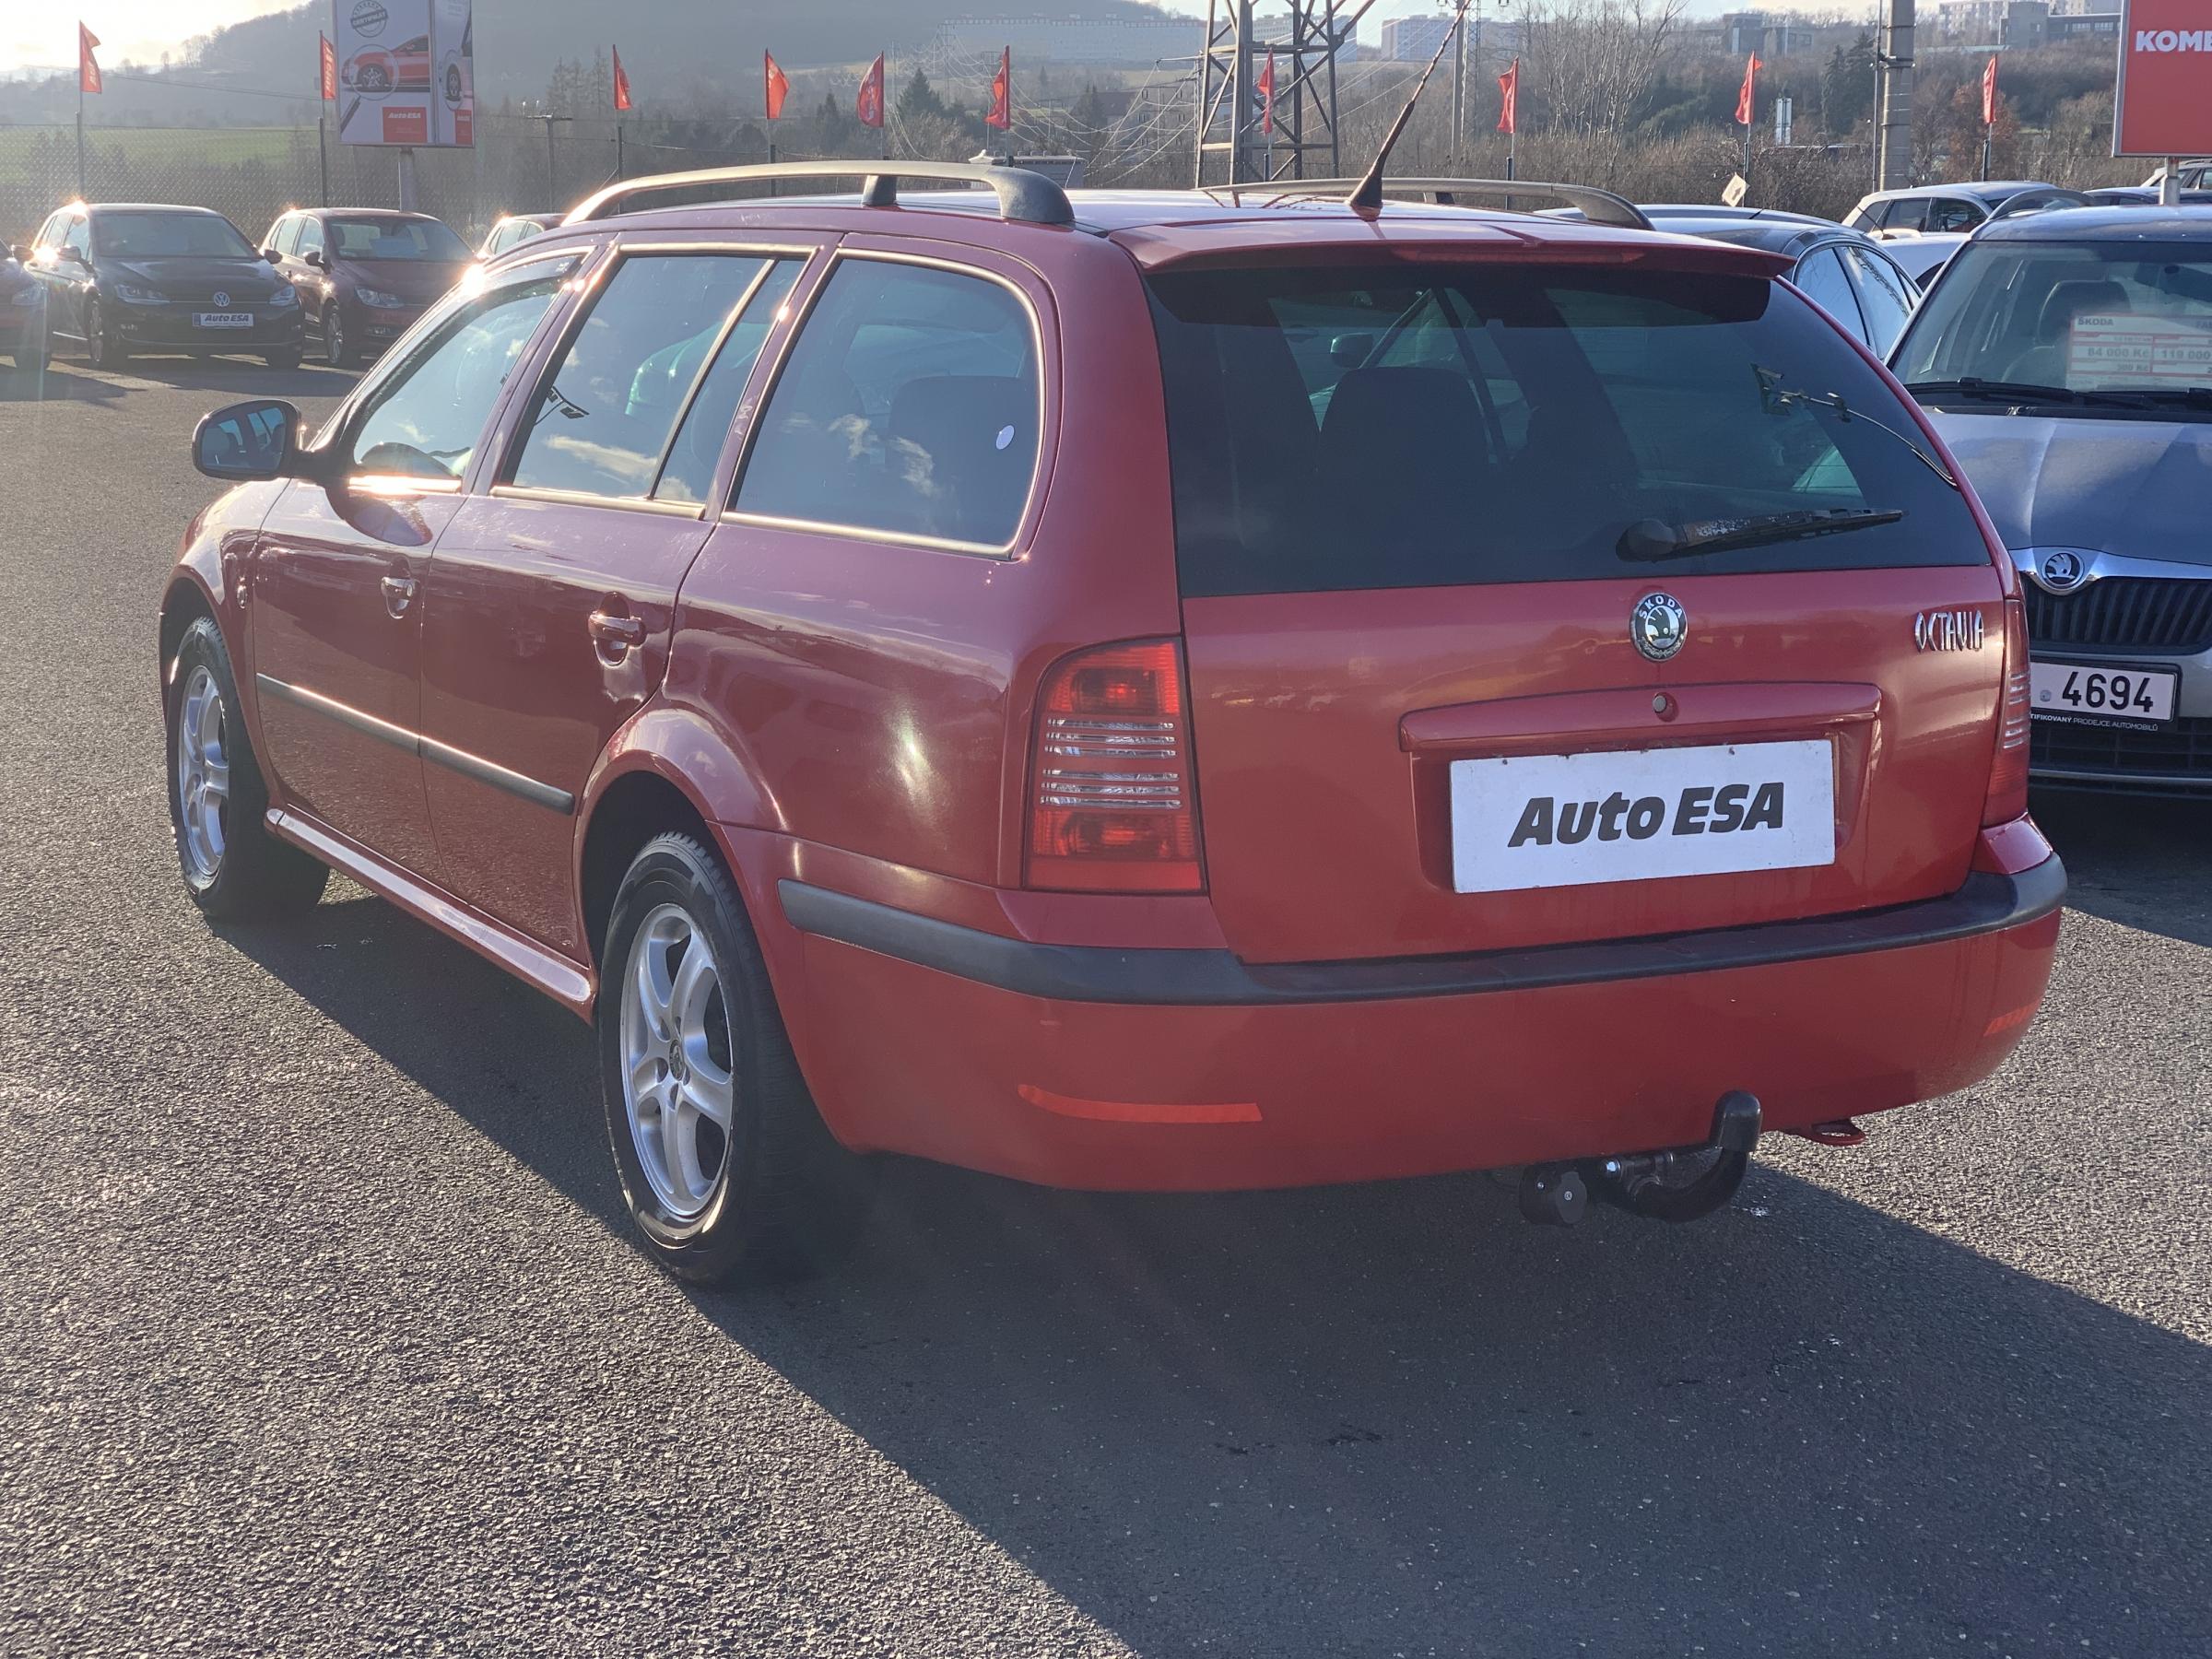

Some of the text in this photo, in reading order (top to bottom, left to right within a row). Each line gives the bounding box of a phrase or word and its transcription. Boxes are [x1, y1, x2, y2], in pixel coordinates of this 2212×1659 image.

[1915, 609, 1985, 653] OCTAVIA
[2062, 671, 2154, 712] 4694
[2073, 717, 2112, 727] PRODEJCE
[2112, 721, 2159, 732] AUTOMOBILŮ
[1507, 782, 1784, 848] Auto ESA
